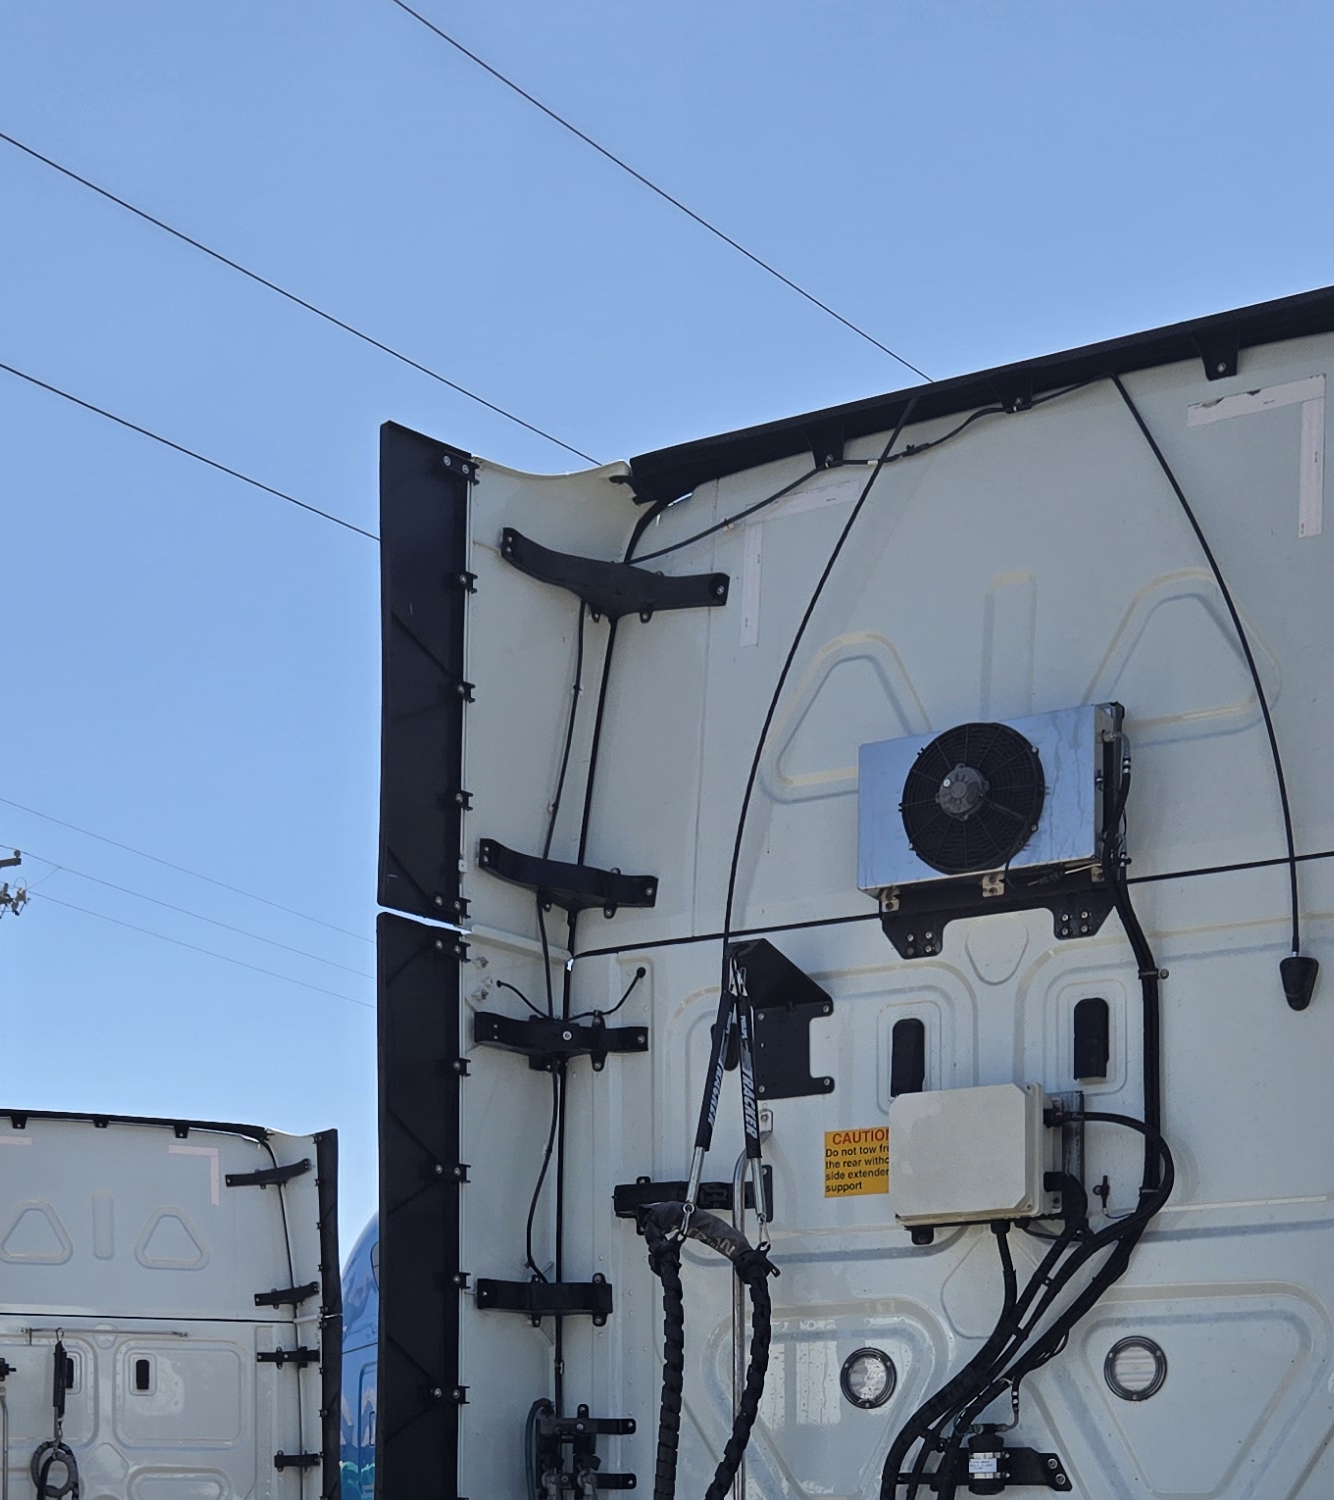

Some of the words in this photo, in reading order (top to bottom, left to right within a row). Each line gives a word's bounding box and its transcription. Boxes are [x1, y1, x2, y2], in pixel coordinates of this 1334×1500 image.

[742, 1069, 757, 1140] TRACKER
[825, 1148, 838, 1157] Do
[841, 1147, 857, 1156] not
[859, 1145, 876, 1155] tow
[825, 1161, 840, 1169] the
[843, 1159, 861, 1168] rear
[825, 1171, 845, 1181] side
[825, 1181, 862, 1193] support
